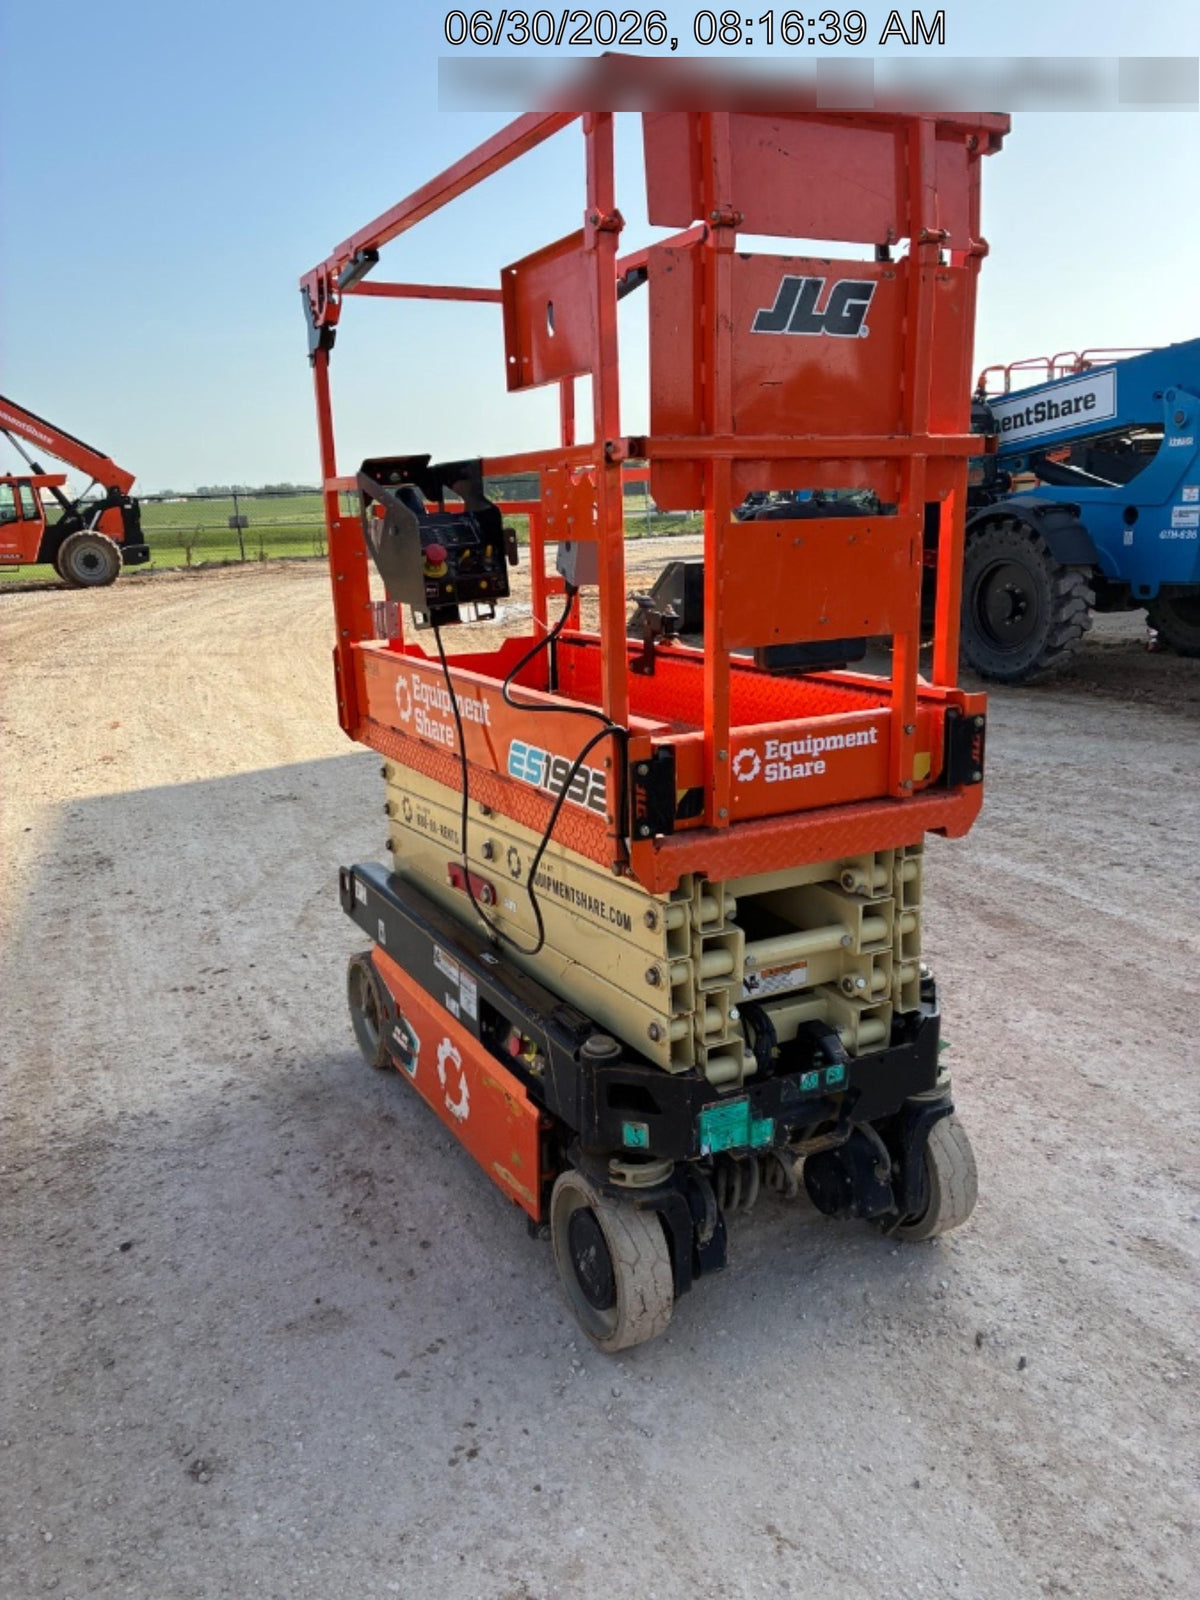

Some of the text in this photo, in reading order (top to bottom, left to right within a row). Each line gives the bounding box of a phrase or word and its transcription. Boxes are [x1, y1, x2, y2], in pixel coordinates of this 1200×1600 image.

[750, 274, 878, 338] JLG
[411, 673, 491, 727] Equipment
[414, 706, 455, 748] Share
[764, 726, 878, 762] Equipment
[764, 758, 826, 784] Share
[508, 739, 608, 817] ES1932
[532, 871, 632, 932] QUIPMENTSHARE.COM
